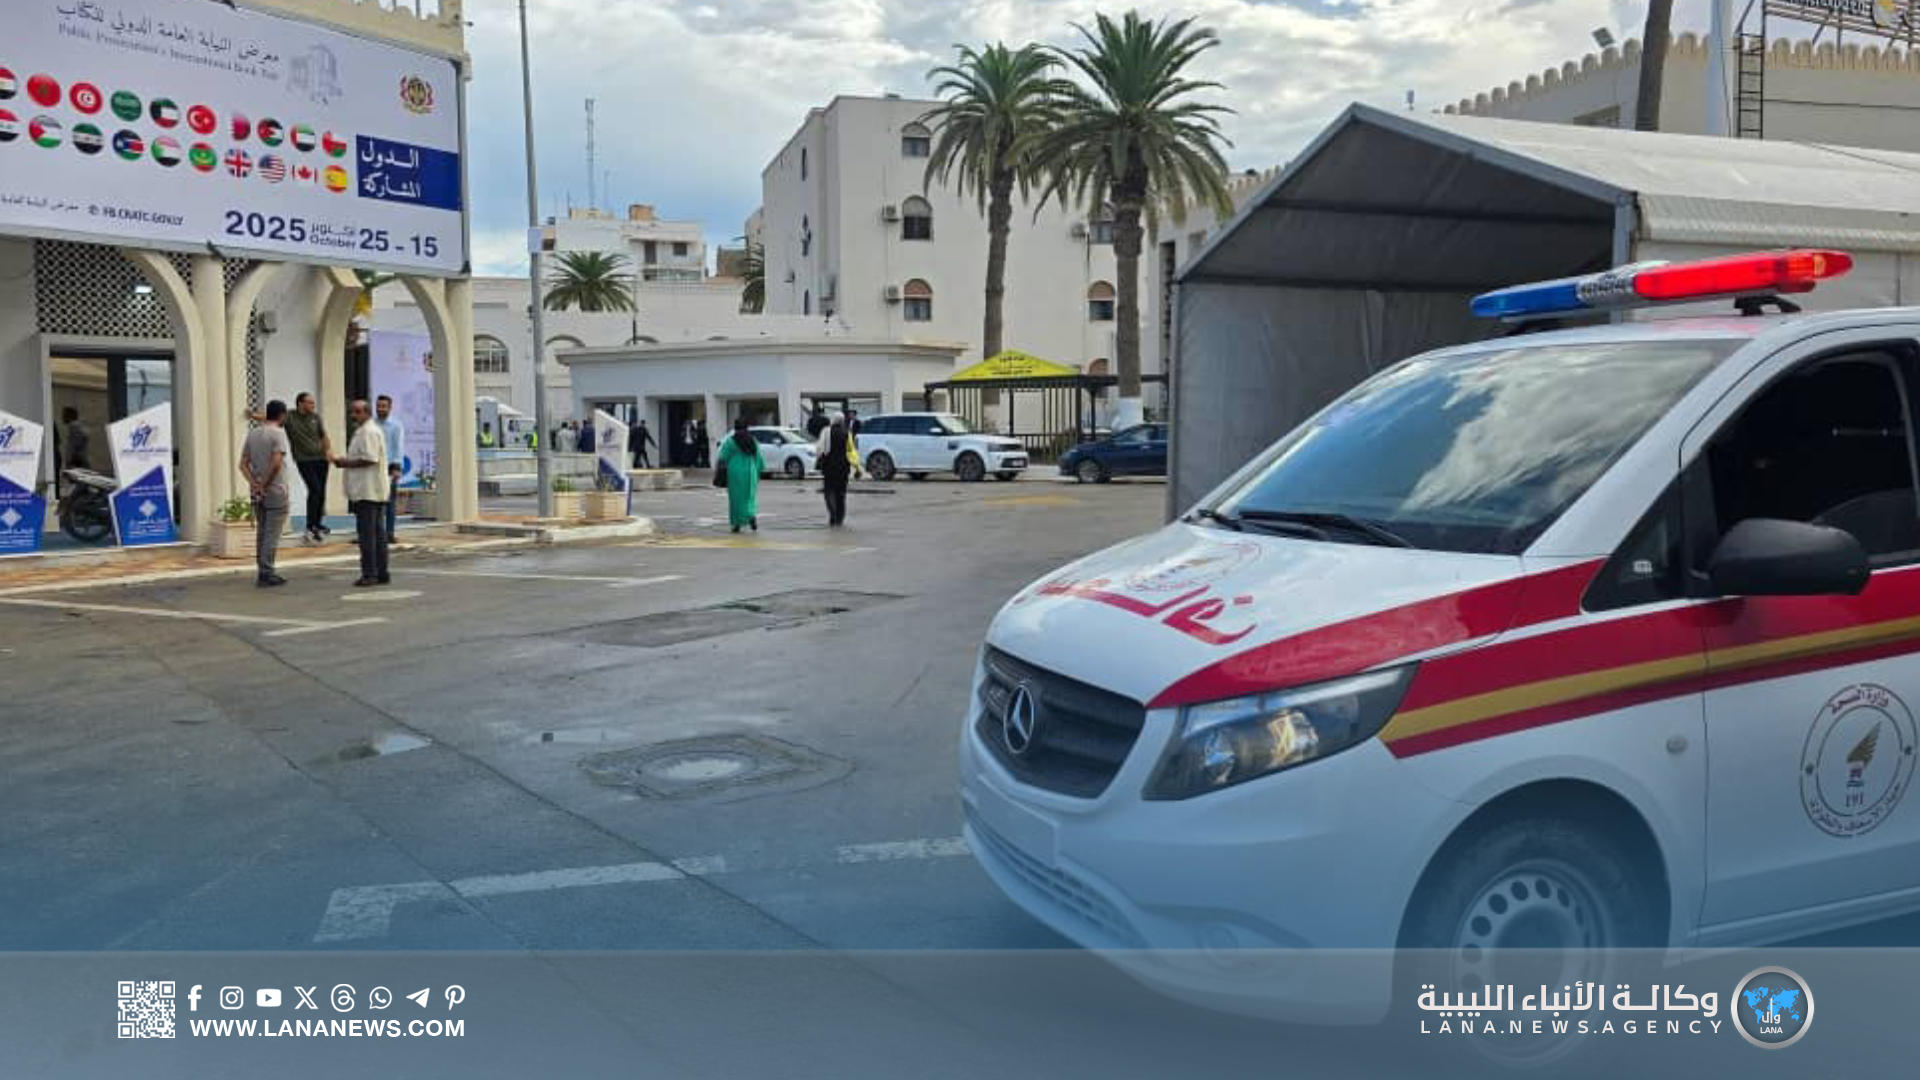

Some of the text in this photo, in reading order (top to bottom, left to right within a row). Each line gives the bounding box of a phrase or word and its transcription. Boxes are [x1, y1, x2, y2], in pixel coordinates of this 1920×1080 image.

[111, 9, 151, 34] الدولي
[158, 20, 194, 43] العامة
[198, 29, 231, 52] النيابة
[238, 44, 279, 64] معرض
[361, 136, 419, 168] الدول
[362, 172, 421, 198] المشاركة
[225, 210, 306, 242] 2025
[309, 234, 356, 249] October
[359, 228, 389, 251] 25
[410, 235, 438, 257] 15
